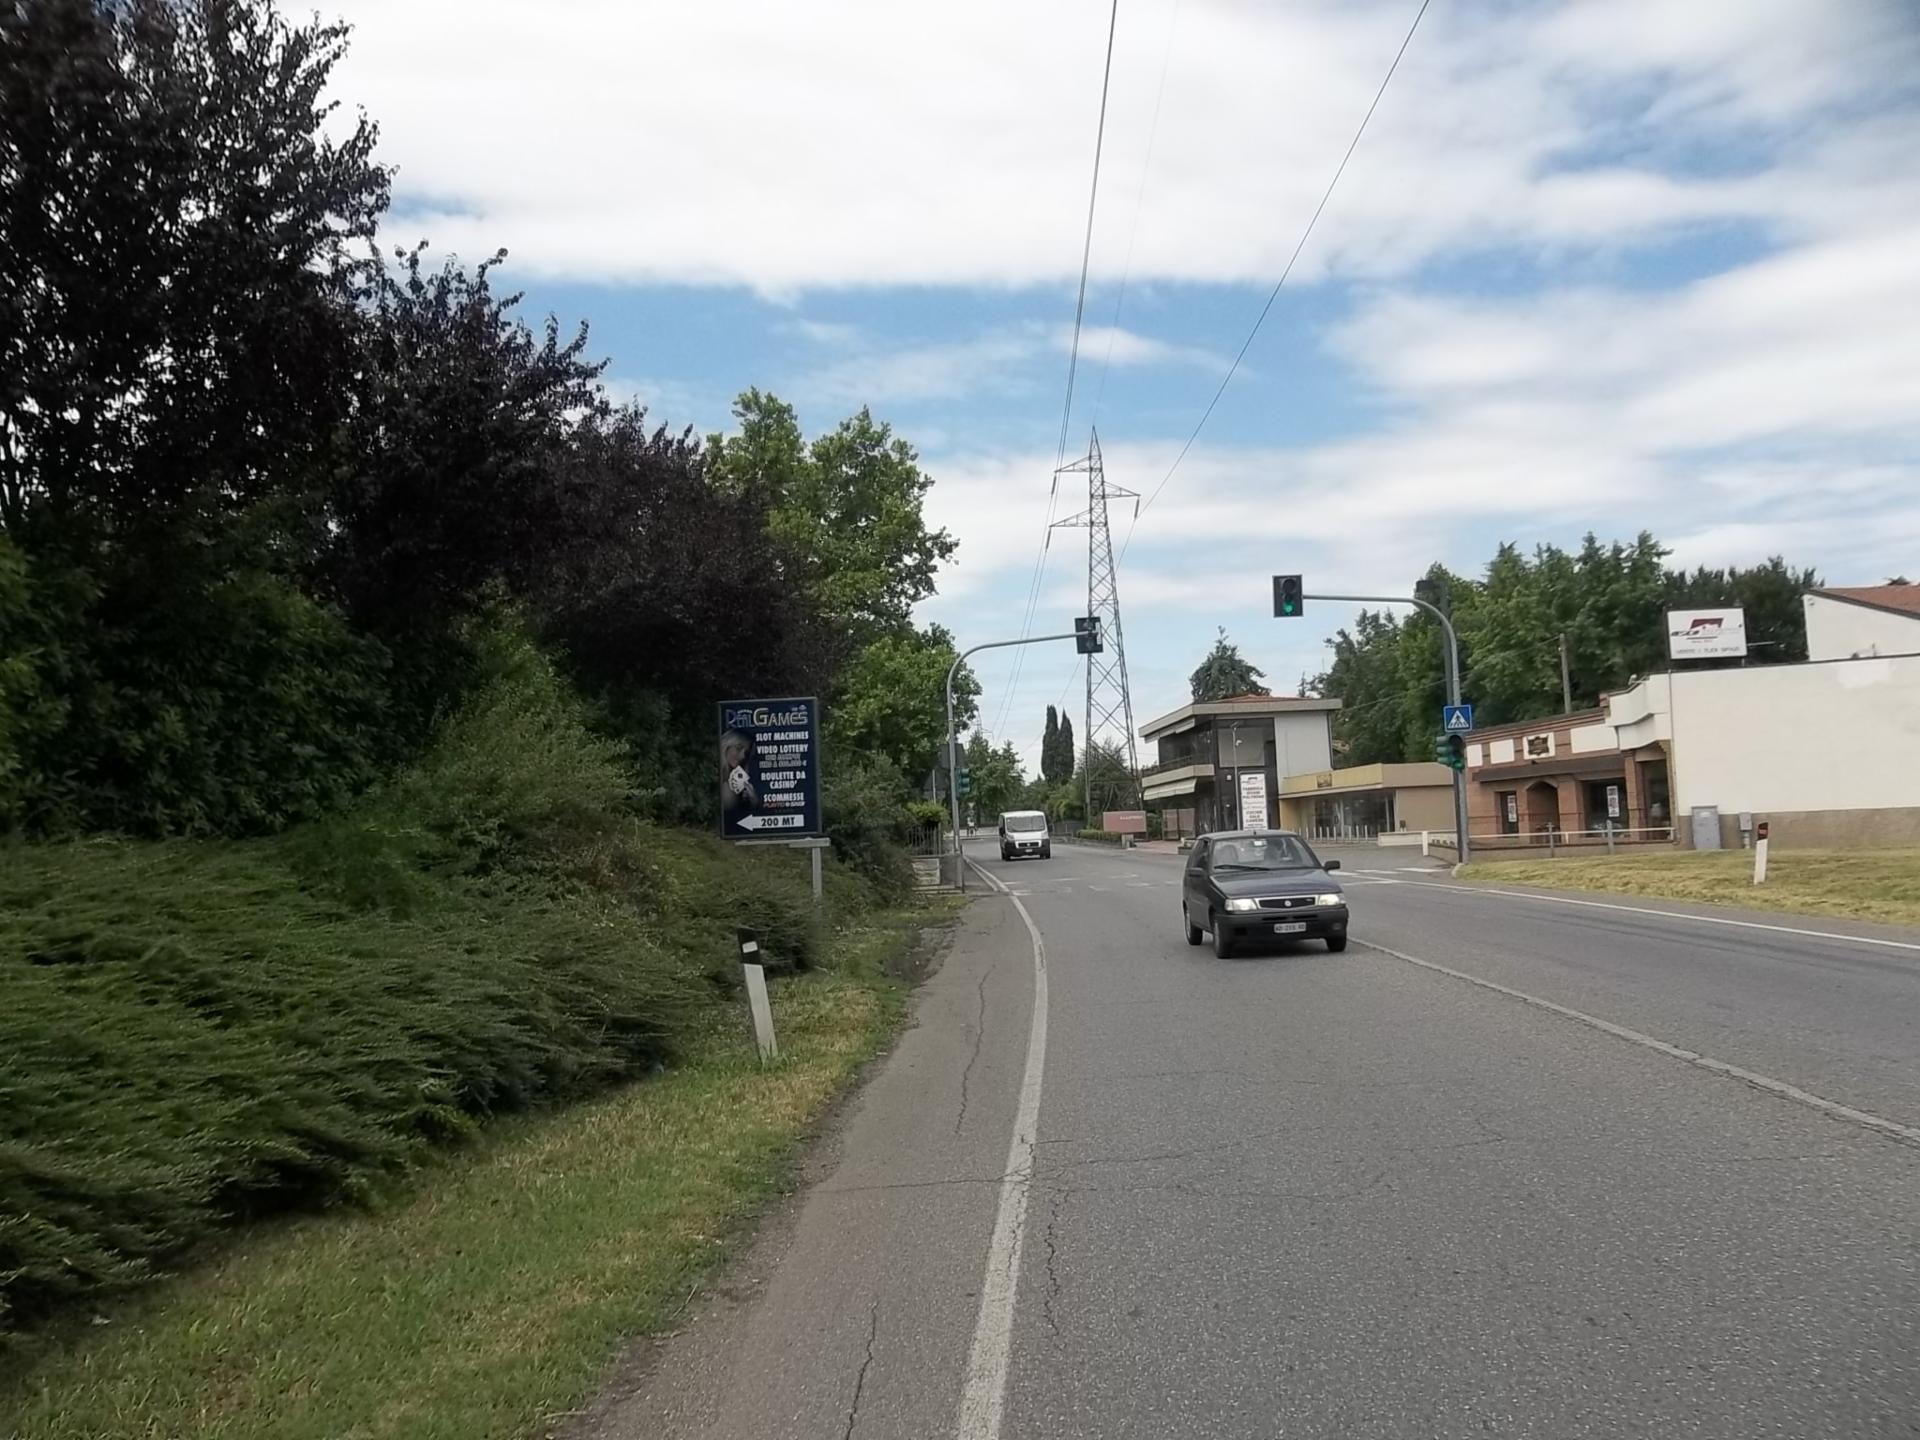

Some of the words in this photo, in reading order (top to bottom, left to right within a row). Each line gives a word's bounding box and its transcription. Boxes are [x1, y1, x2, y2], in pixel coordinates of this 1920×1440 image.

[755, 733, 772, 742] SLOT
[773, 731, 809, 741] MACHINES
[756, 745, 778, 754] VIDEO
[780, 744, 808, 753] LOTTERY
[760, 771, 795, 781] ROULETTE
[796, 771, 806, 779] DA
[763, 792, 804, 802] SCOMMESSE
[761, 817, 779, 827] 200
[782, 816, 795, 826] MT
